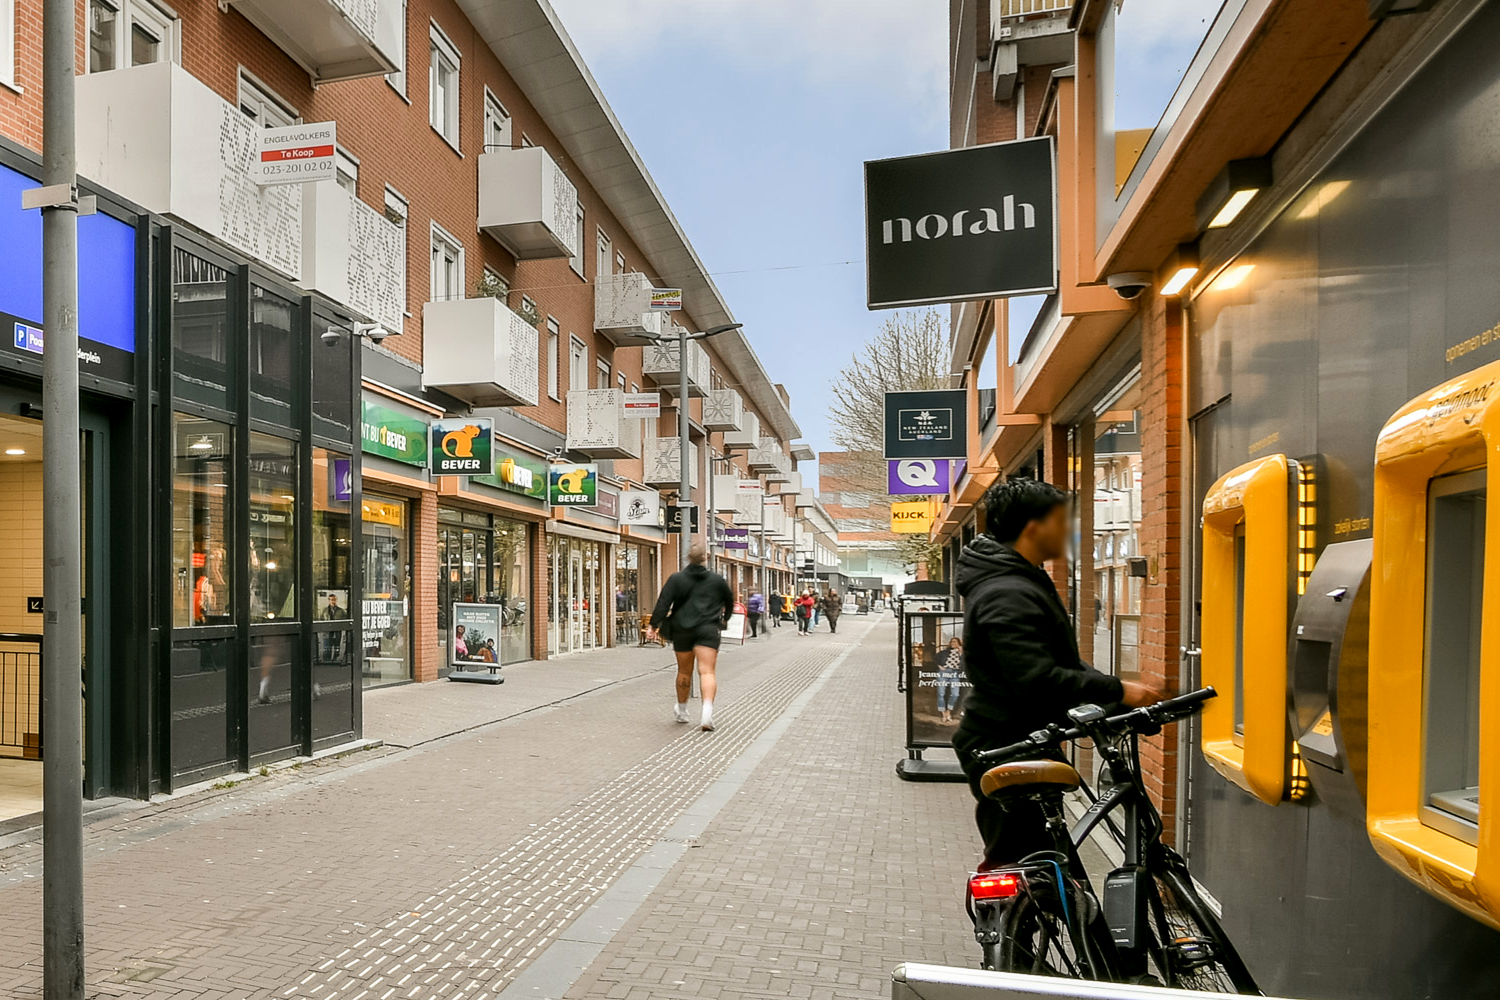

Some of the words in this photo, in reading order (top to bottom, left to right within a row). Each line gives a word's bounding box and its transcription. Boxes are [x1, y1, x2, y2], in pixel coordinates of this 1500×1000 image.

[280, 150, 292, 158] Te
[292, 148, 314, 158] Koop
[263, 163, 302, 175] 023-201
[304, 162, 318, 172] 02
[320, 160, 333, 170] 02
[882, 194, 1036, 245] norah
[18, 329, 25, 342] P
[387, 430, 406, 451] BEVER
[441, 460, 481, 469] BEVER
[558, 495, 588, 503] BEVER
